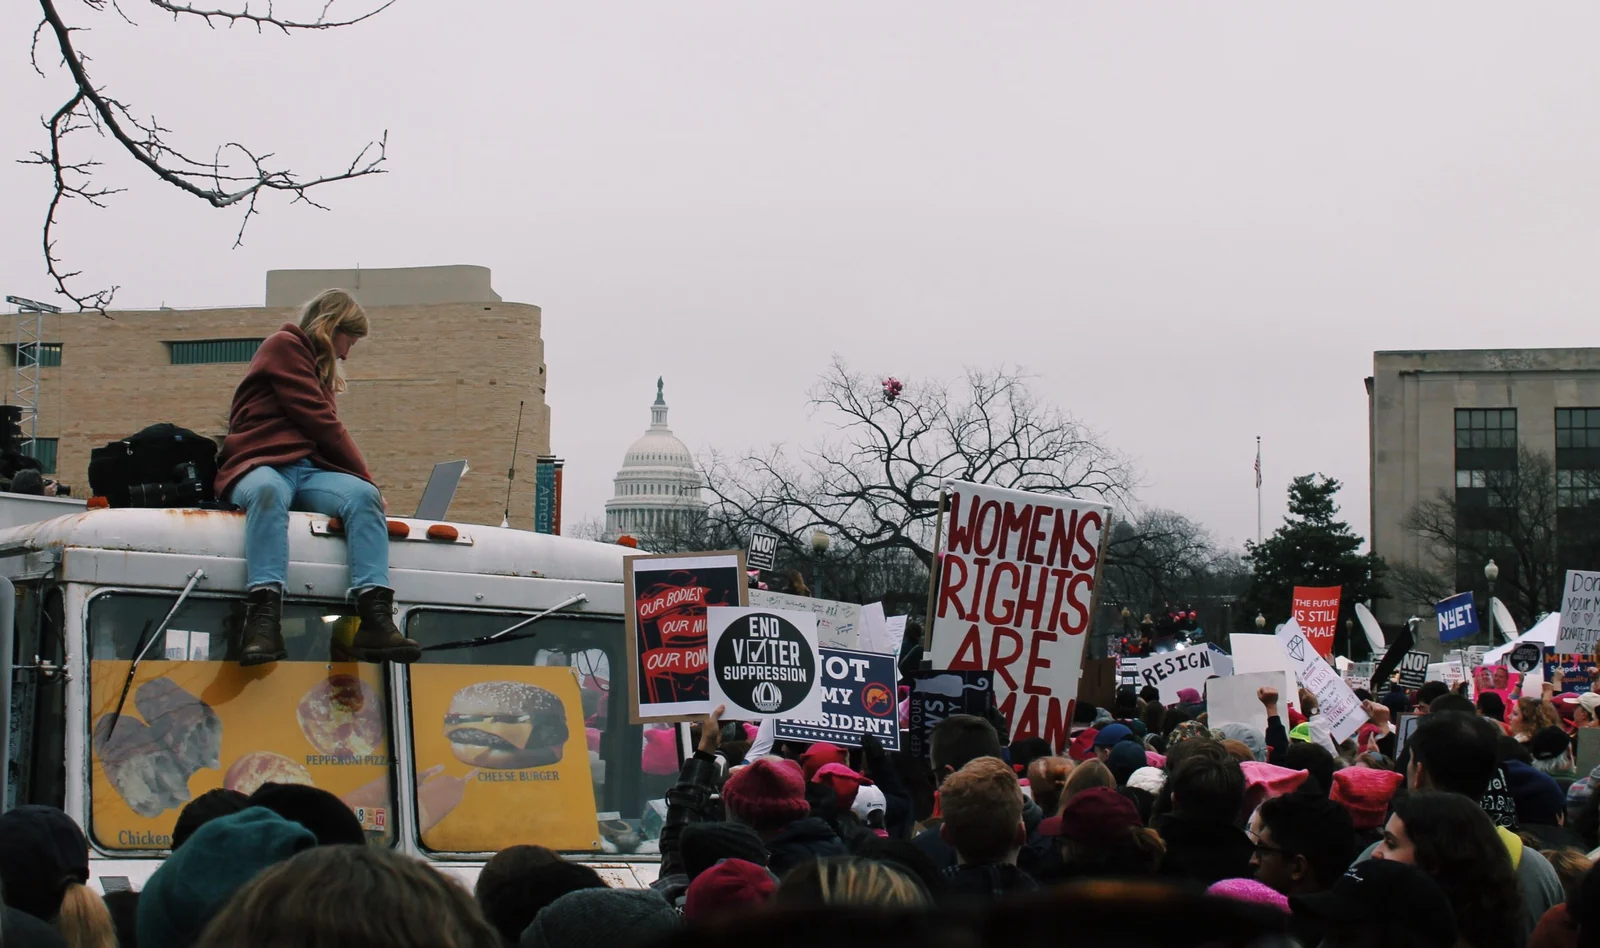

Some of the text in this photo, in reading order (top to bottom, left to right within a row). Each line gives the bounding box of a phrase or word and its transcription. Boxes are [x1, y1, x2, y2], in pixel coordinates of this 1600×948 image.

[948, 491, 1102, 571] WOMENS
[752, 534, 775, 555] NO!
[640, 587, 703, 616] OUR BODIES
[937, 554, 1094, 635] RIGHTS
[1294, 598, 1338, 607] THE FUTURE
[1294, 609, 1336, 622] IS STILL
[662, 619, 707, 634] OUR MI
[749, 616, 780, 638] END
[1300, 625, 1336, 638] EMALE
[647, 652, 680, 670] OUR
[820, 654, 870, 683] OT
[947, 624, 1058, 697] ARE
[1141, 650, 1211, 686] RESIGN
[1402, 653, 1428, 672] NO!
[723, 665, 807, 683] SUPPRESSION
[821, 686, 853, 705] MY
[779, 712, 894, 735] SIDENT
[911, 699, 922, 730] YOUR
[306, 754, 362, 766] PEPPERONI
[477, 770, 560, 782] CHEESE BURGER
[118, 830, 170, 845] Chicken
